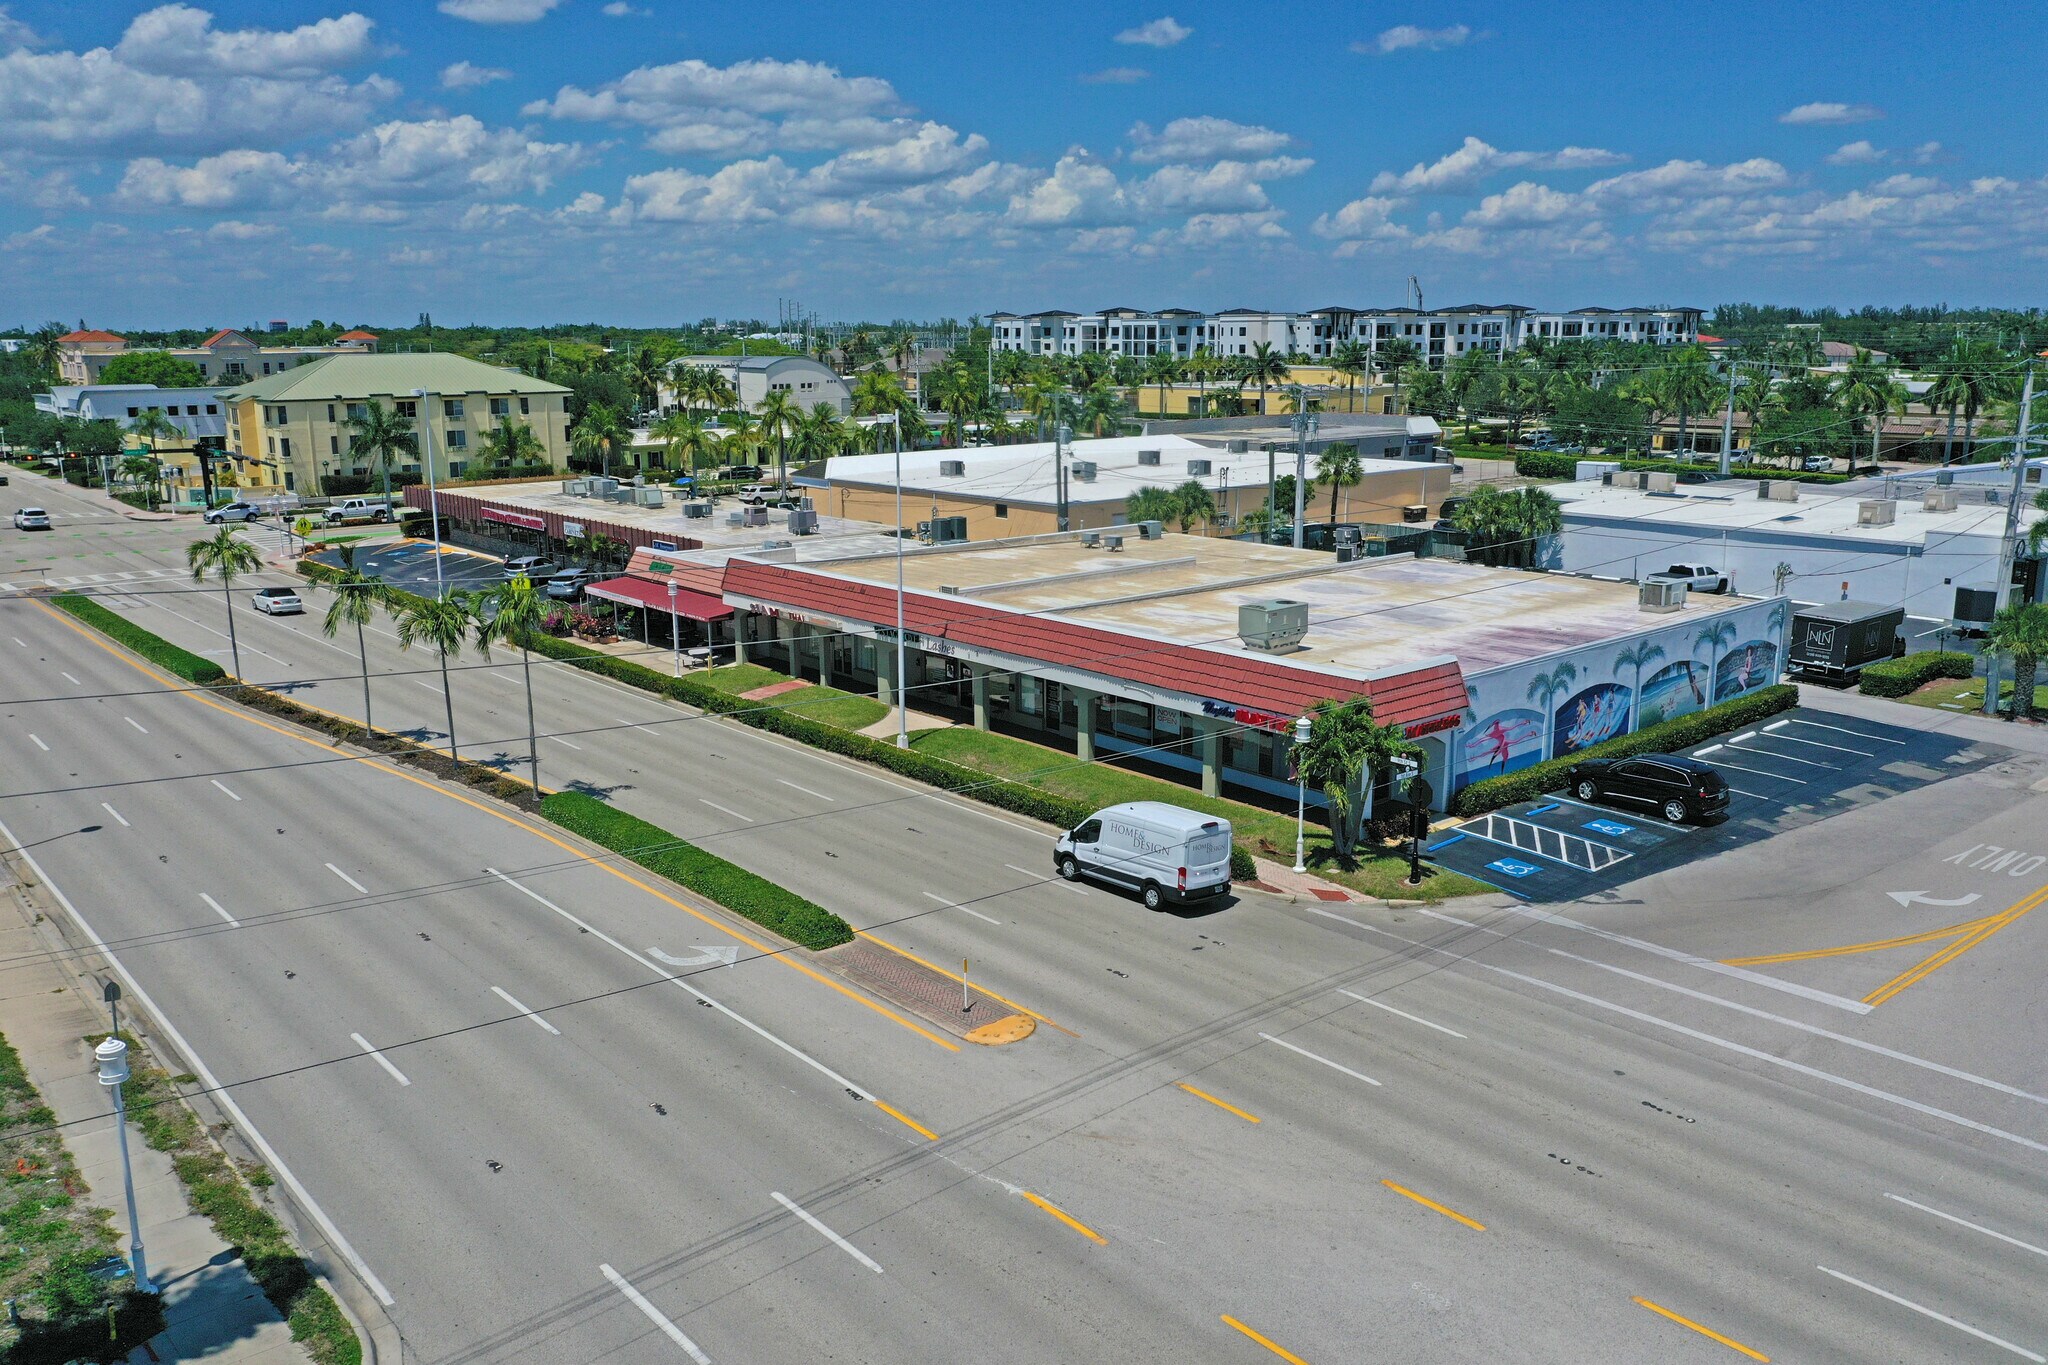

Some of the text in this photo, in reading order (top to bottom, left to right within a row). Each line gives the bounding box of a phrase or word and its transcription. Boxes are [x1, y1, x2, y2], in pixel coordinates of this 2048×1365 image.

[750, 603, 780, 618] SIAM
[1809, 629, 1832, 646] NLN
[926, 637, 956, 656] Lashes
[1156, 715, 1178, 726] OPEN
[1157, 708, 1178, 718] NOW
[1110, 822, 1142, 840] HOME
[1133, 838, 1171, 857] DESIGN
[1192, 842, 1211, 852] HOME
[1206, 844, 1227, 854] DESIGN
[1942, 843, 2047, 877] ONLY
